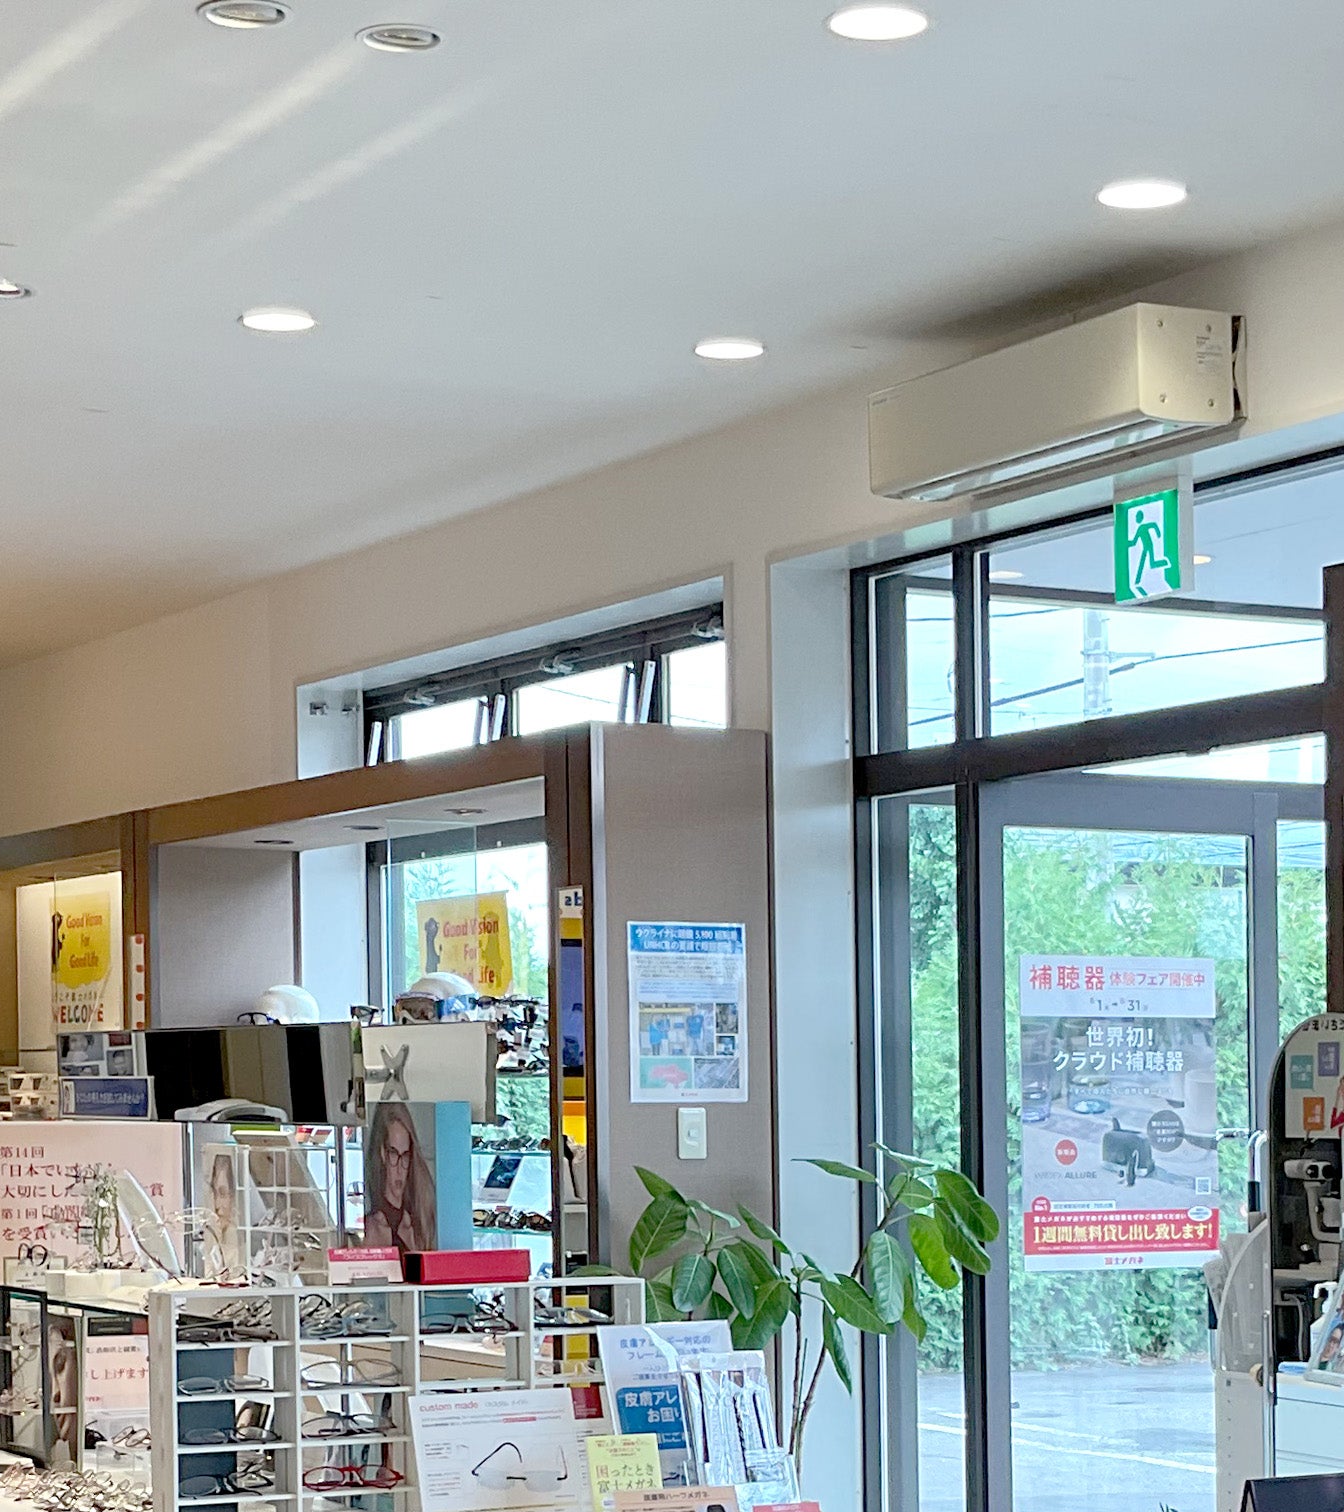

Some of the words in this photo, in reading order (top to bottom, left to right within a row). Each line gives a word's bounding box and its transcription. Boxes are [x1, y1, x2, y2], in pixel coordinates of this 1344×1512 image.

[443, 920, 467, 937] Good
[1029, 964, 1105, 990] 補聴器
[1053, 1050, 1184, 1072] クラウド補聴器
[0, 1146, 45, 1159] 第14回
[1064, 1171, 1097, 1179] ALLURE
[419, 1401, 452, 1412] custom
[455, 1399, 479, 1410] made
